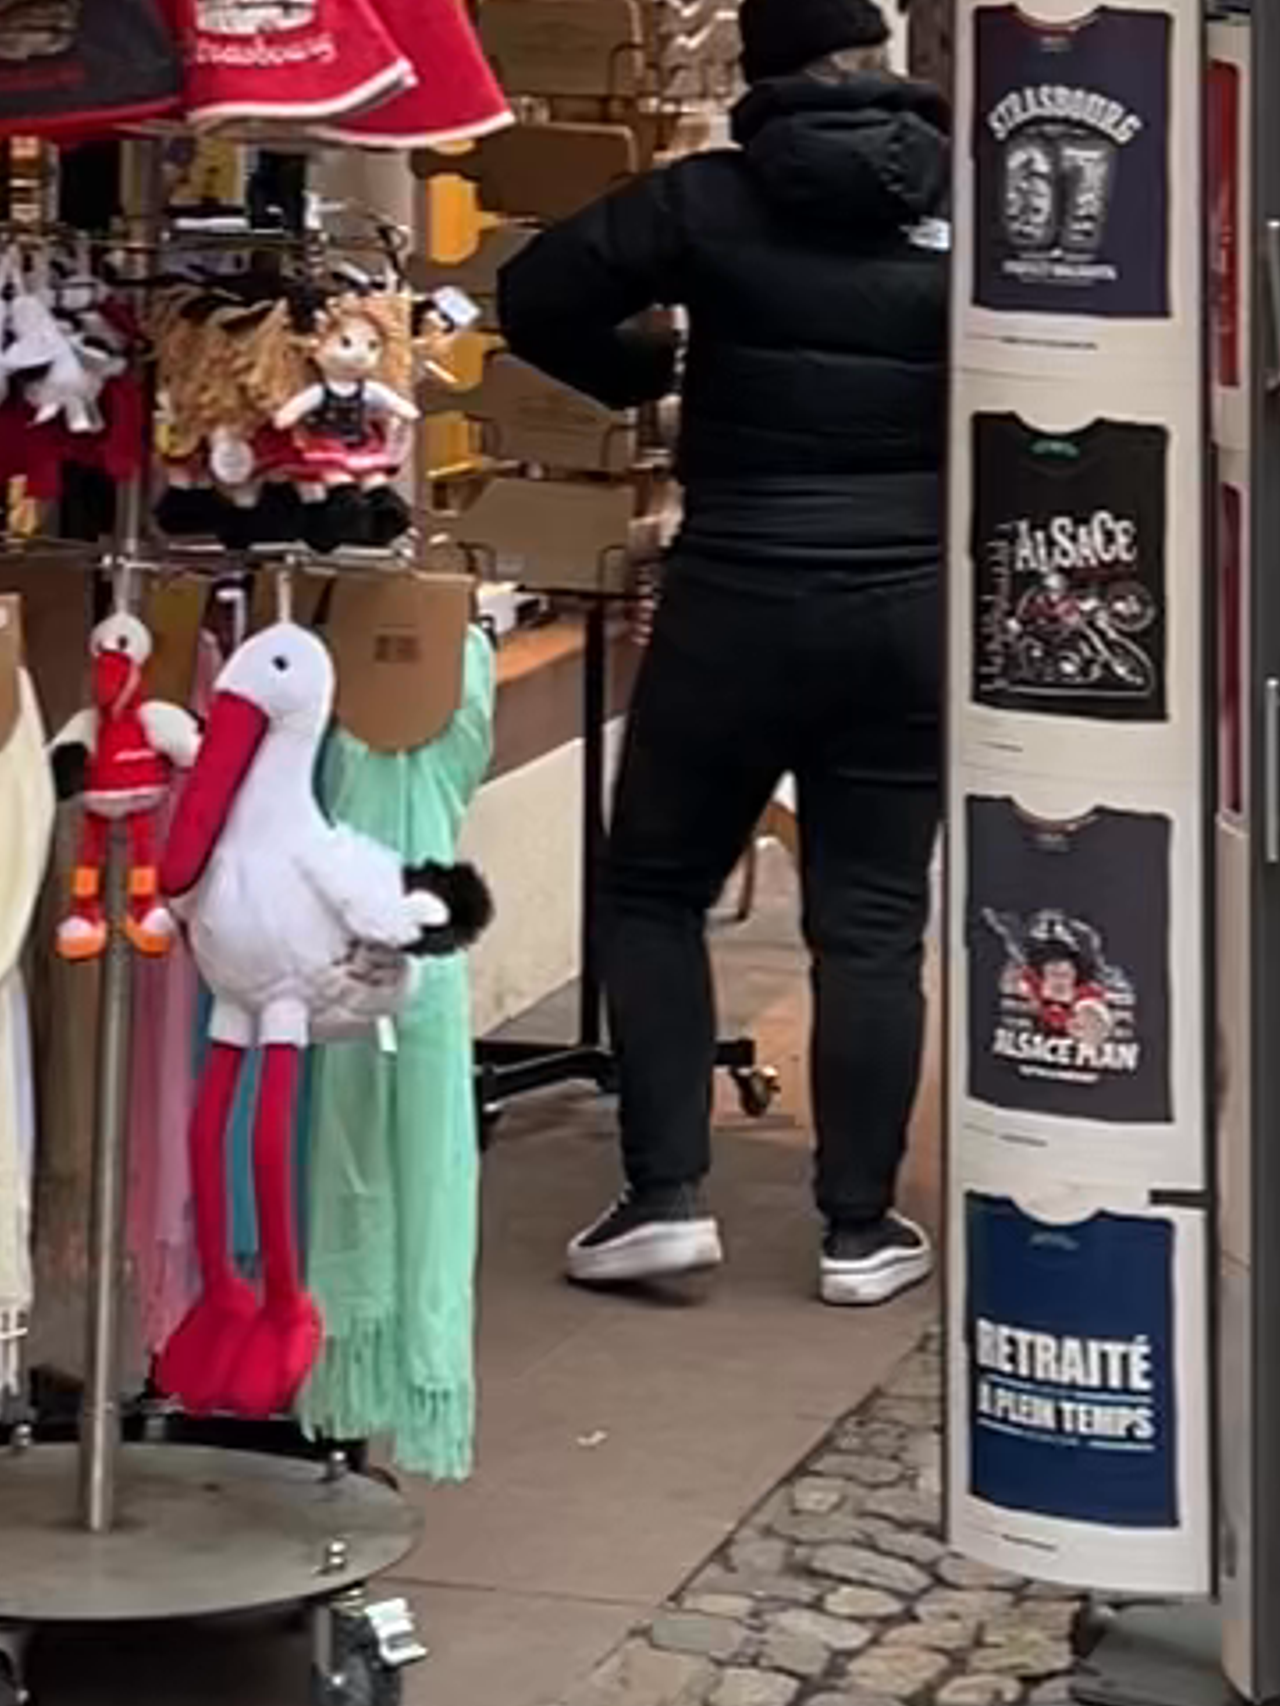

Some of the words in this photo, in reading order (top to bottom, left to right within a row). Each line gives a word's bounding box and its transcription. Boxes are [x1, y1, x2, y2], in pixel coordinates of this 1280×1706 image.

[1015, 509, 1138, 573] ALSACE
[992, 1027, 1074, 1066] ALSACE
[1075, 1042, 1140, 1072] MAN
[976, 1316, 1153, 1391] RETRAITÉ
[994, 1386, 1057, 1432] PLEIN
[1060, 1399, 1156, 1440] TEMPS
